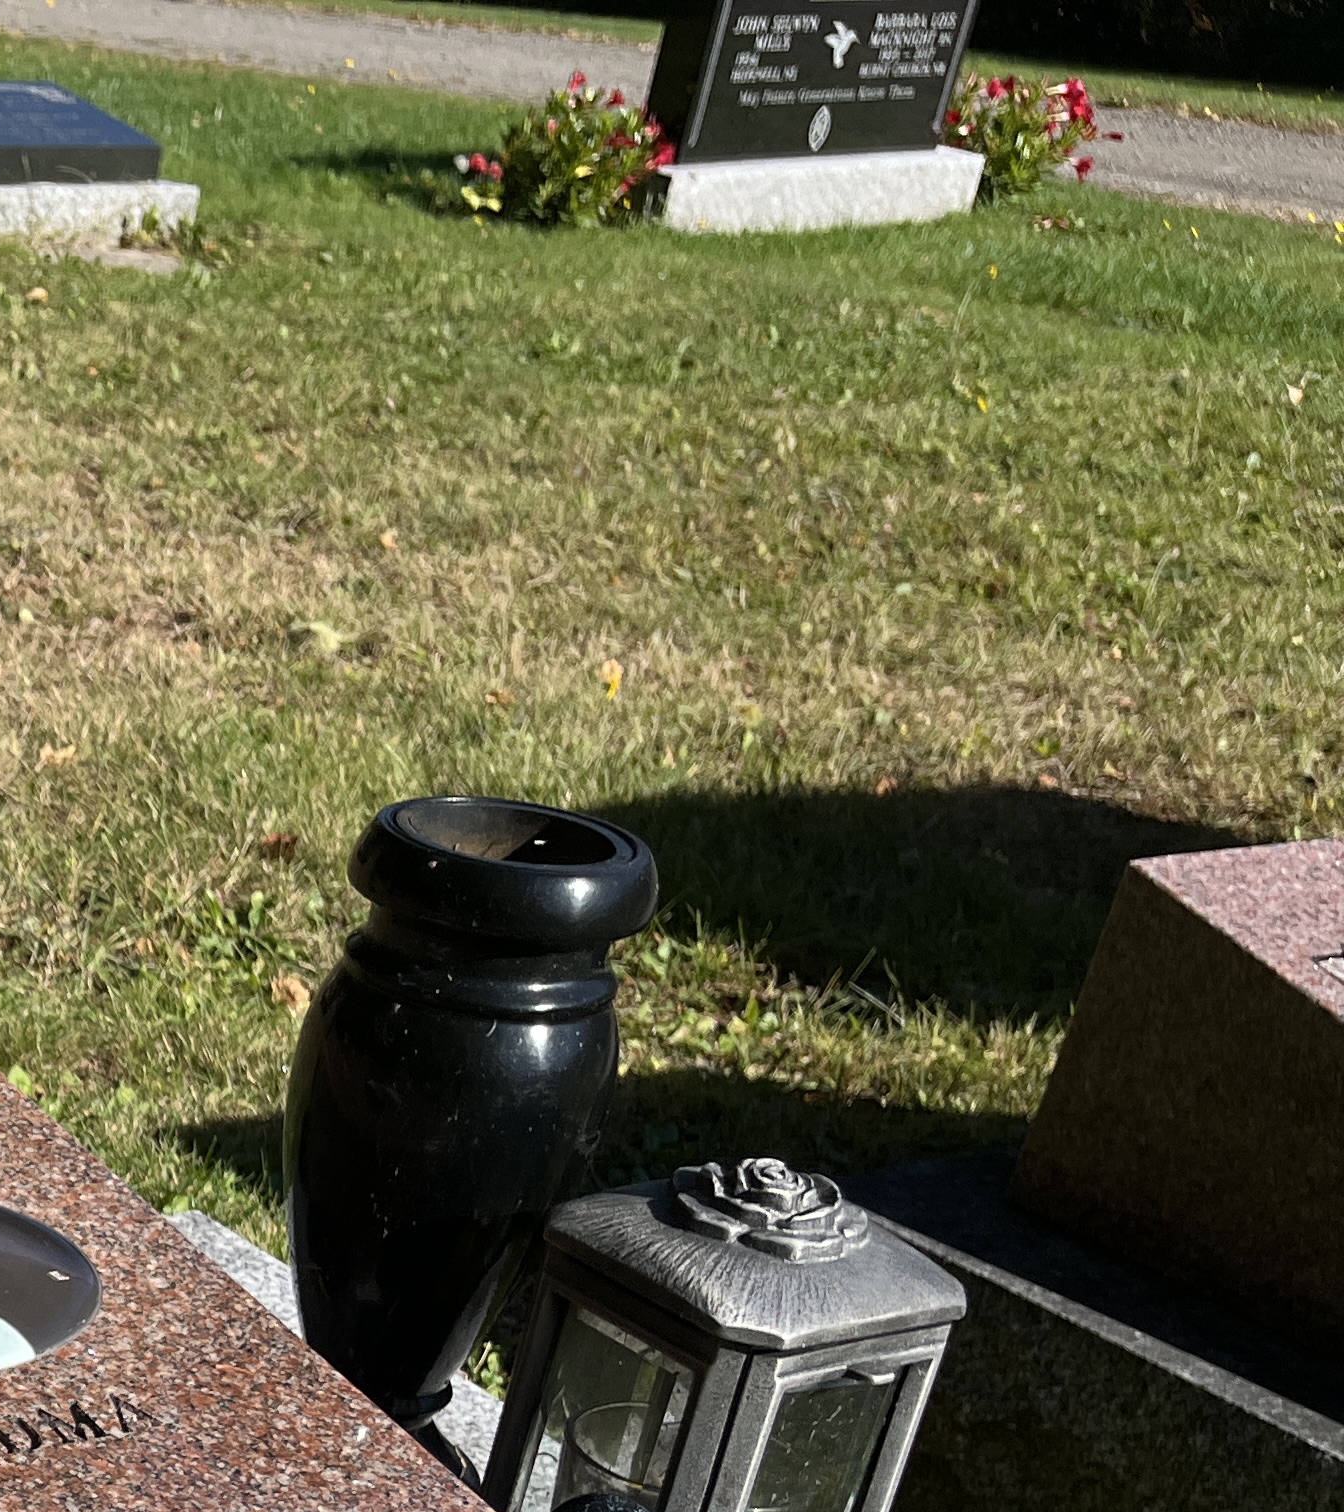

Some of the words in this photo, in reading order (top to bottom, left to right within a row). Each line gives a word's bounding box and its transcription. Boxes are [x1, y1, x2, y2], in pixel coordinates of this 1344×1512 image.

[732, 15, 770, 35] JOHN
[930, 11, 957, 30] LOIS
[739, 88, 761, 109] May
[761, 88, 797, 106] Future
[797, 86, 857, 104] Generations
[857, 85, 886, 102] Know
